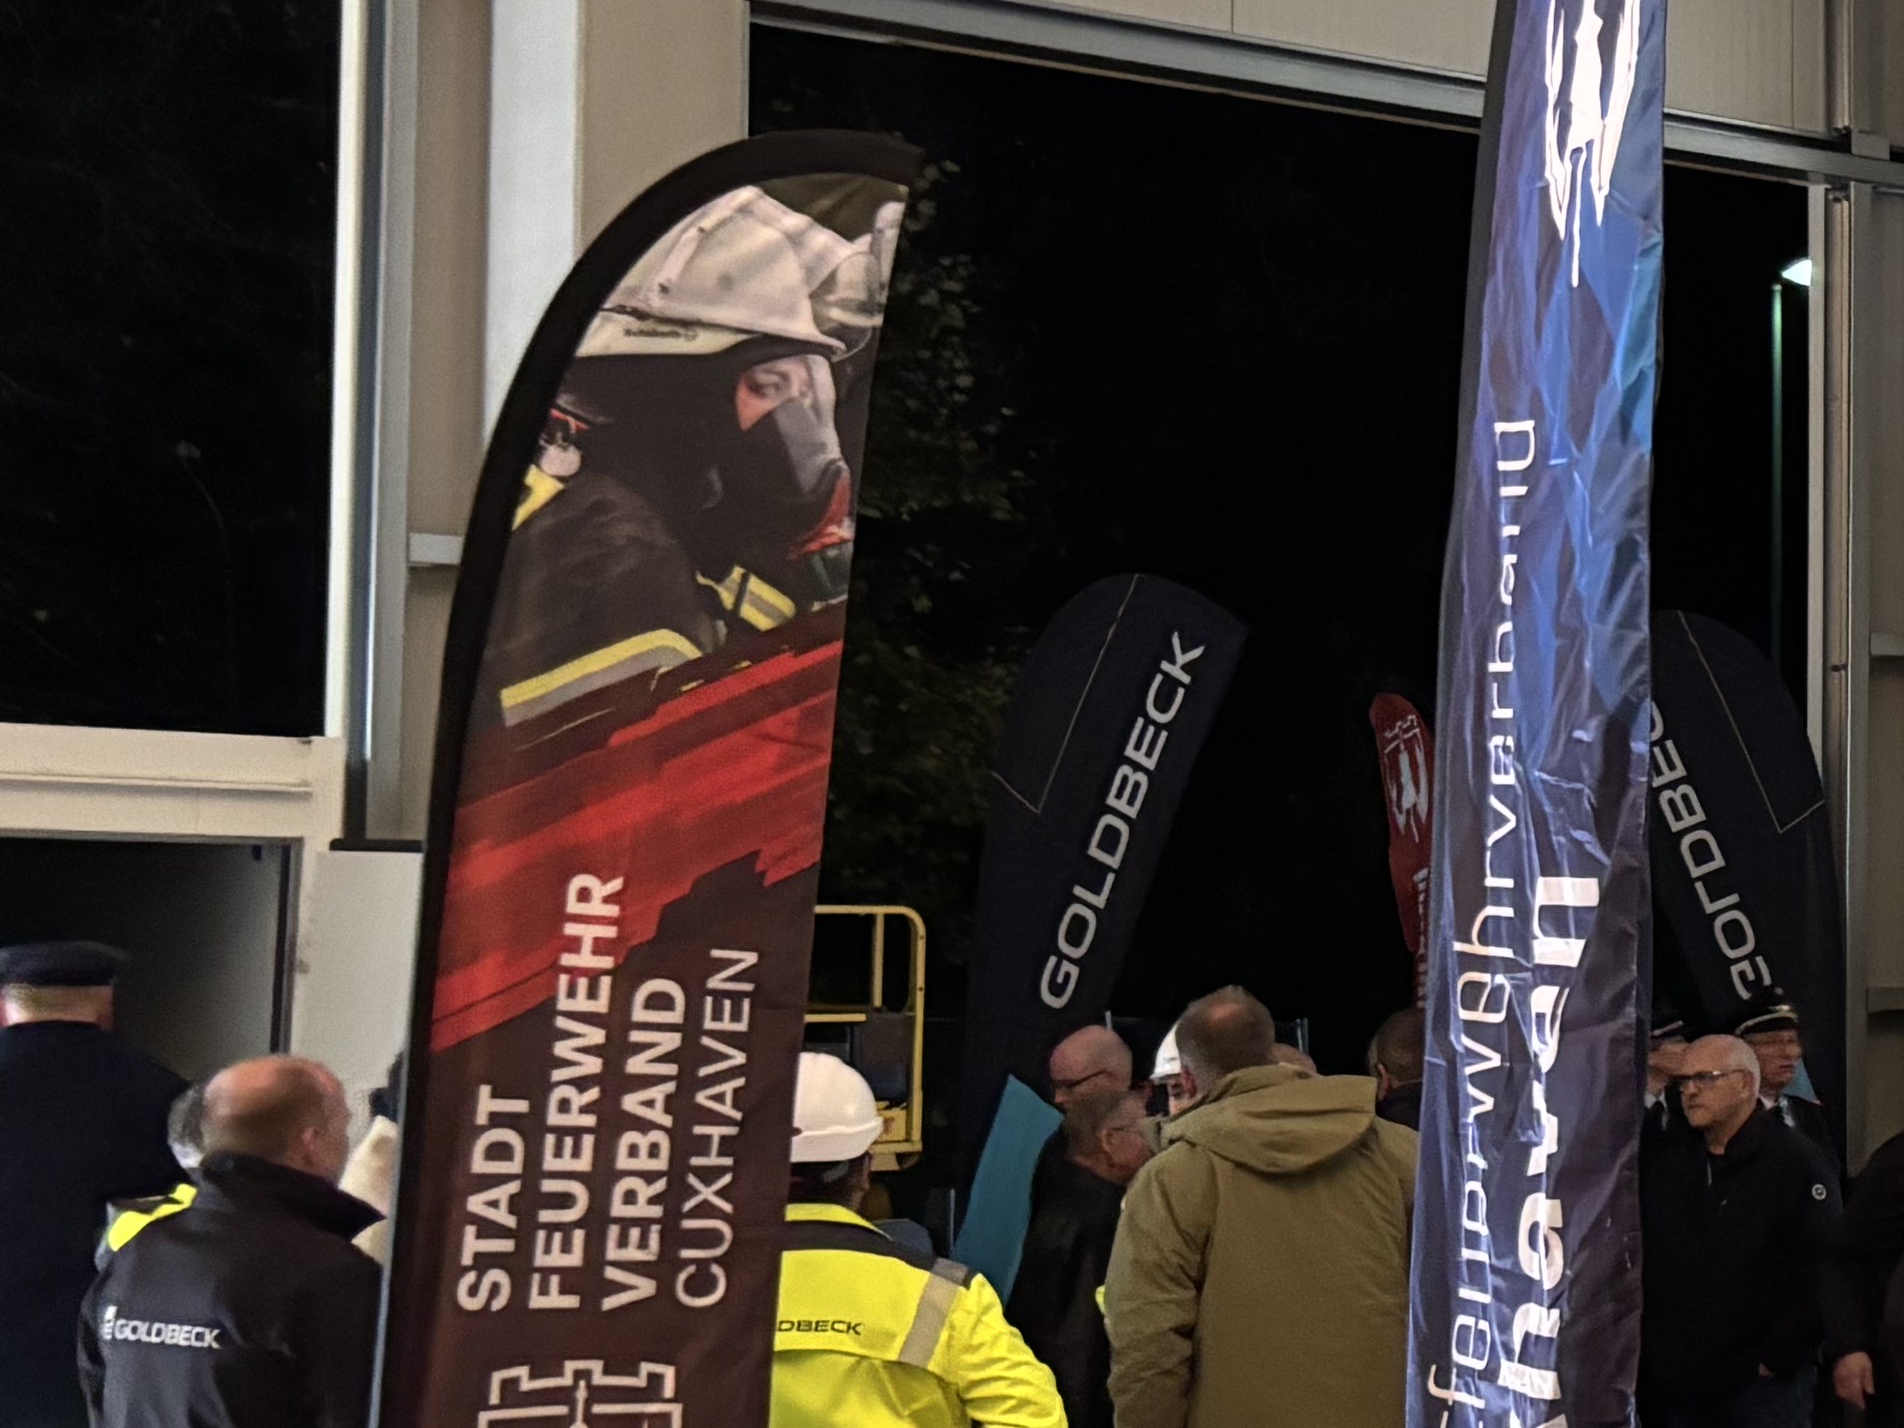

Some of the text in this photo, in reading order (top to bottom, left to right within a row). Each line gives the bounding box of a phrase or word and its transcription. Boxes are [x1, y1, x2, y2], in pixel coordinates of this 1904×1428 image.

[1039, 629, 1206, 1010] GOLDBECK
[456, 1084, 531, 1312] STADT
[528, 871, 626, 1311] FEUERWEHR
[600, 976, 688, 1312] VERBAND
[674, 947, 760, 1310] CUXHAVEN
[114, 1318, 222, 1350] GOLDBECK
[777, 1319, 862, 1336] DBECK
